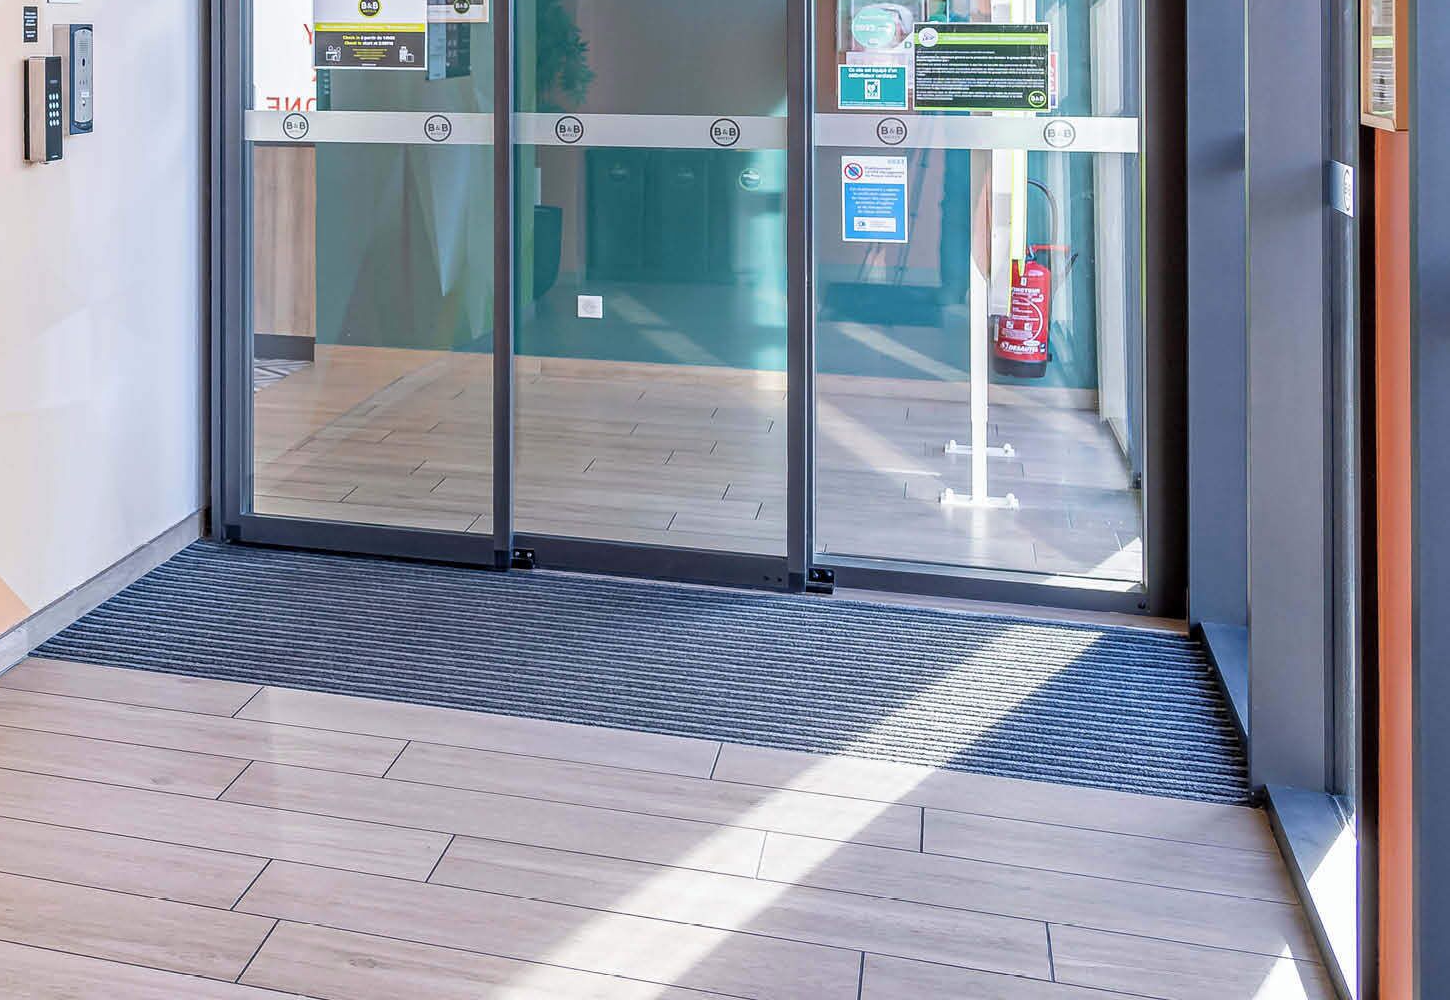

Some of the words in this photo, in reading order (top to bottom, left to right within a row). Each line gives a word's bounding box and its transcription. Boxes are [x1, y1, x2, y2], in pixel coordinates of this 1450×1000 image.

[286, 122, 306, 130] B&B
[428, 123, 449, 132] B&B
[559, 124, 580, 134] B&B
[881, 126, 903, 135] B&B
[714, 127, 736, 136] B&B
